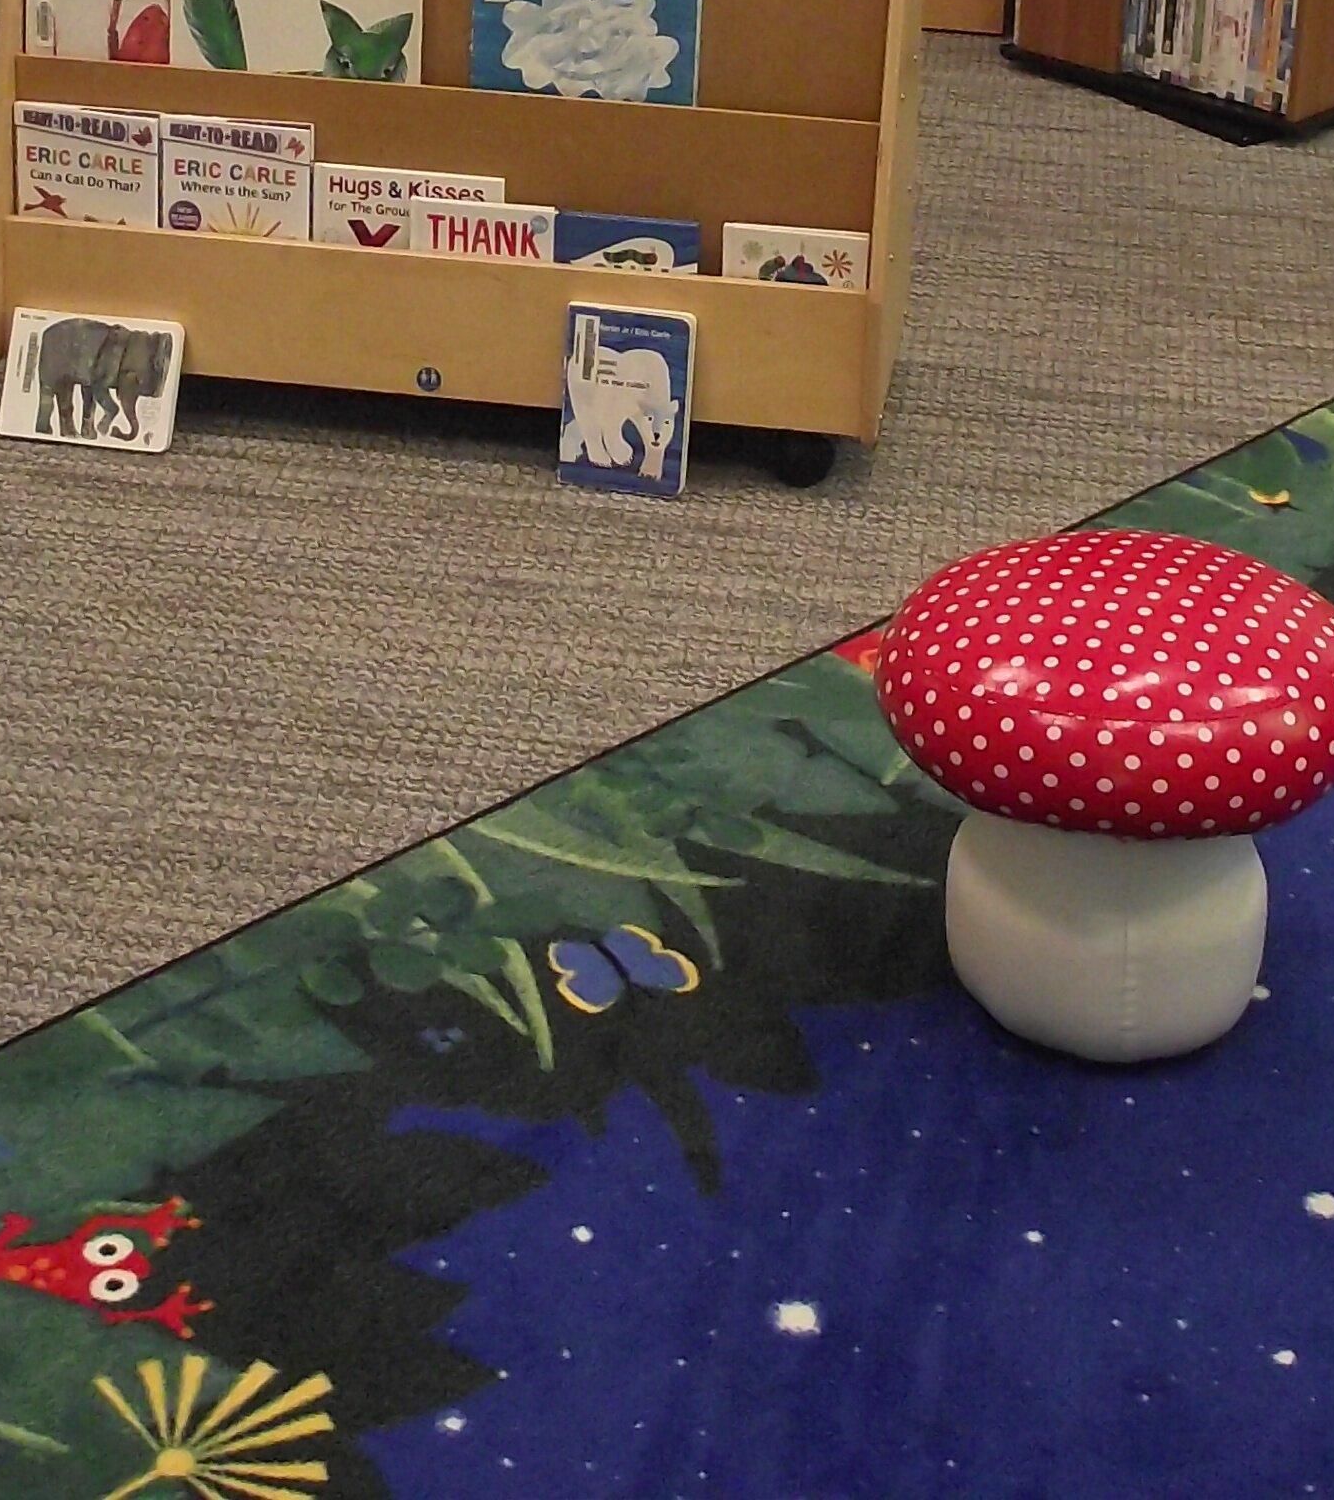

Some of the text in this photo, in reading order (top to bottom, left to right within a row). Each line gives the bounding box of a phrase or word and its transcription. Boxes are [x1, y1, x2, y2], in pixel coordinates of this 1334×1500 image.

[26, 145, 143, 175] ERIC CARLE
[174, 158, 297, 186] ERIC CARLE
[30, 168, 52, 181] Can
[65, 173, 84, 185] Cat
[87, 176, 104, 188] Do
[107, 178, 141, 192] That?
[181, 181, 222, 195] Where
[238, 186, 259, 198] the
[261, 189, 291, 202] Sun?
[329, 176, 485, 202] Hugs & Kisses
[329, 200, 347, 212] for
[351, 201, 373, 215] The
[426, 213, 540, 259] THANK
